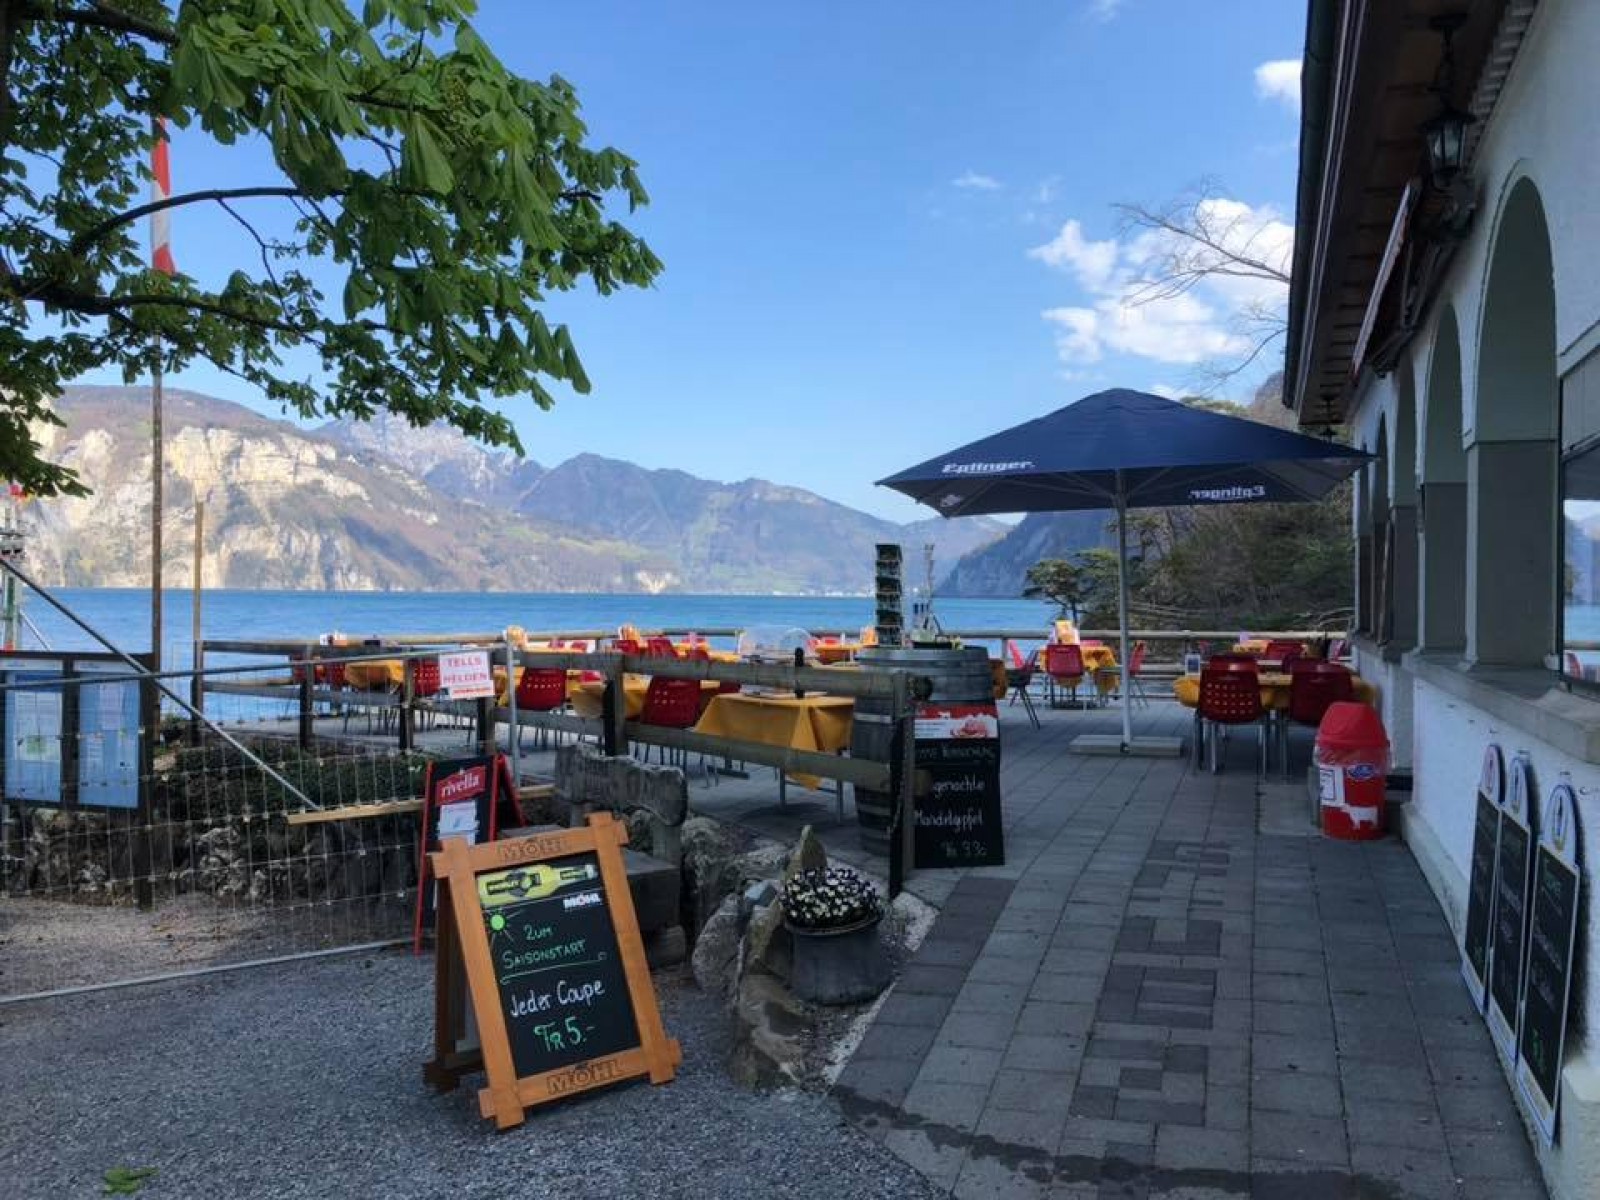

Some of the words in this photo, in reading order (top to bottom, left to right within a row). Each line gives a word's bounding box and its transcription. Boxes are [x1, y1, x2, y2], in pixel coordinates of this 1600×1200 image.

[441, 772, 480, 799] rivella
[510, 990, 552, 1017] Jeder
[557, 979, 605, 1006] Coupe
